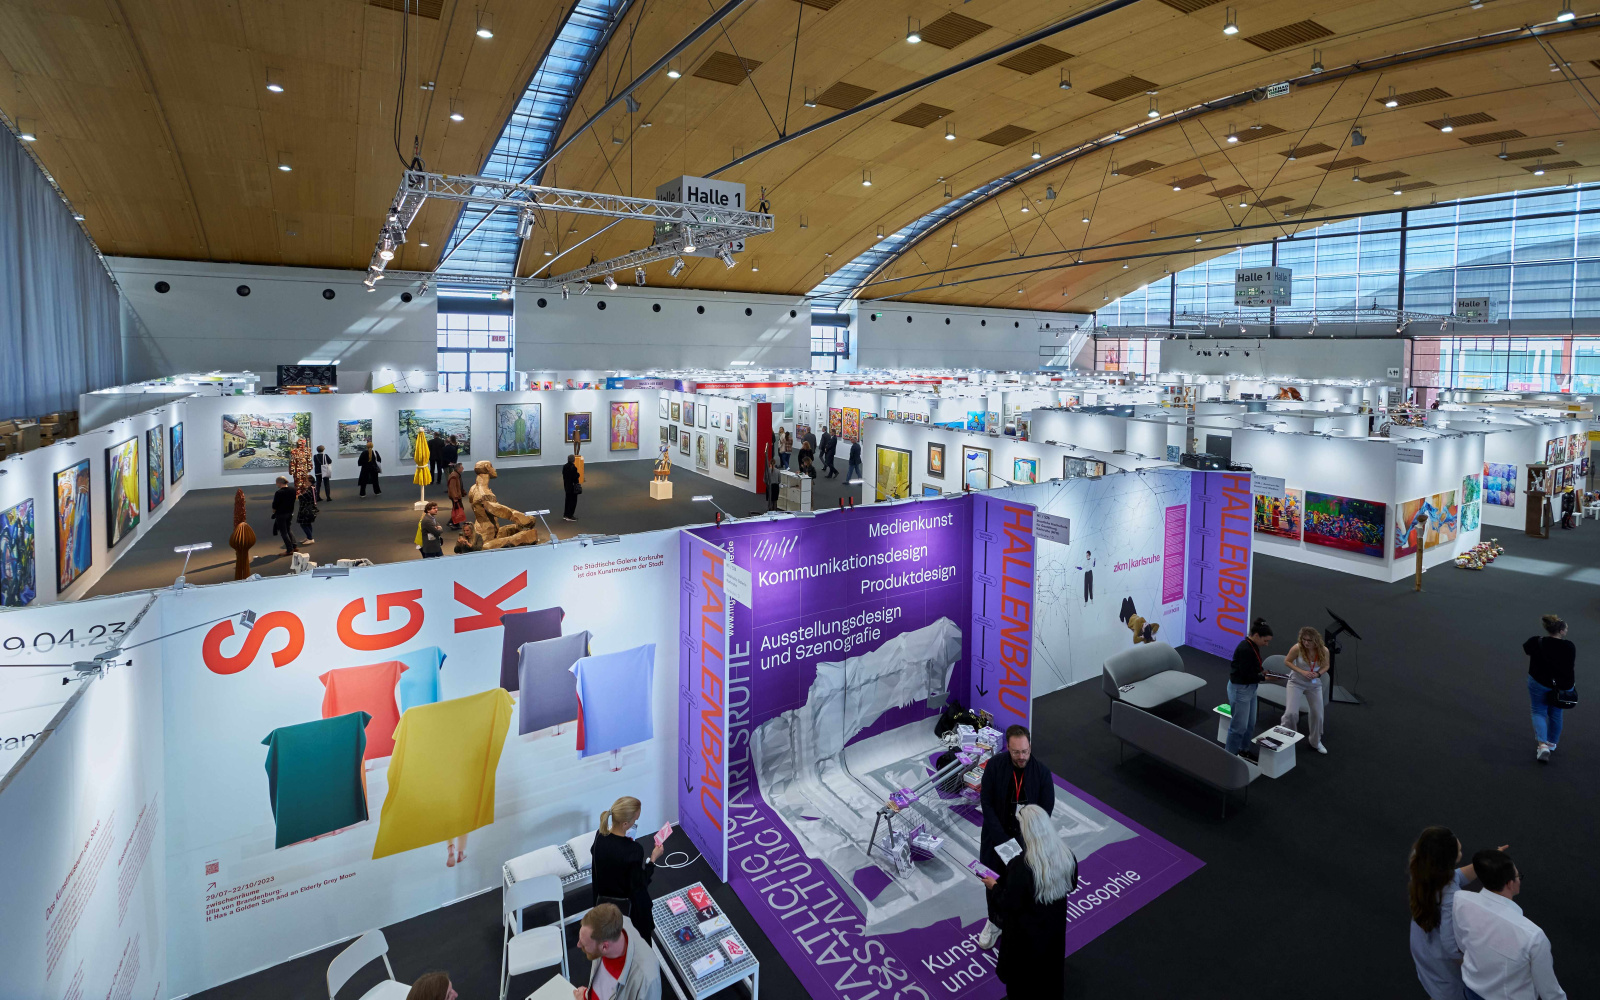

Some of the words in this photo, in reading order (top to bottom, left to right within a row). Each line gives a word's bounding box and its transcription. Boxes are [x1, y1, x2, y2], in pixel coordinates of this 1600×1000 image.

[688, 186, 729, 206] Halle
[734, 192, 740, 208] 1
[1238, 272, 1262, 282] Halle
[1266, 272, 1270, 280] 1
[1274, 272, 1288, 282] Halle
[869, 512, 954, 538] Medienkunst
[584, 560, 615, 570] Städtische
[638, 554, 664, 562] Karlsruhe
[598, 566, 637, 575] Kunstmuseum
[758, 545, 928, 588] Kommunikationsdesign
[1216, 474, 1250, 637] HALLENBAU
[861, 565, 956, 594] Produktdesign
[202, 610, 305, 675] S
[336, 588, 424, 651] G
[454, 570, 528, 634] K
[998, 505, 1033, 719] HALLENBAU
[760, 606, 902, 652] Ausstellungsdesign
[761, 646, 790, 670] und
[796, 626, 880, 660] Szenografie
[700, 548, 724, 832] HALLENBAU
[206, 888, 260, 909] zwischenräume
[206, 906, 220, 916] Ulla
[236, 889, 282, 906] Brandenburg:
[236, 902, 260, 913] Golden
[261, 897, 275, 905] Sun
[276, 892, 289, 900] and
[300, 882, 322, 893] Elderly
[324, 877, 338, 886] Grey
[339, 872, 356, 880] Moon
[942, 958, 988, 992] und
